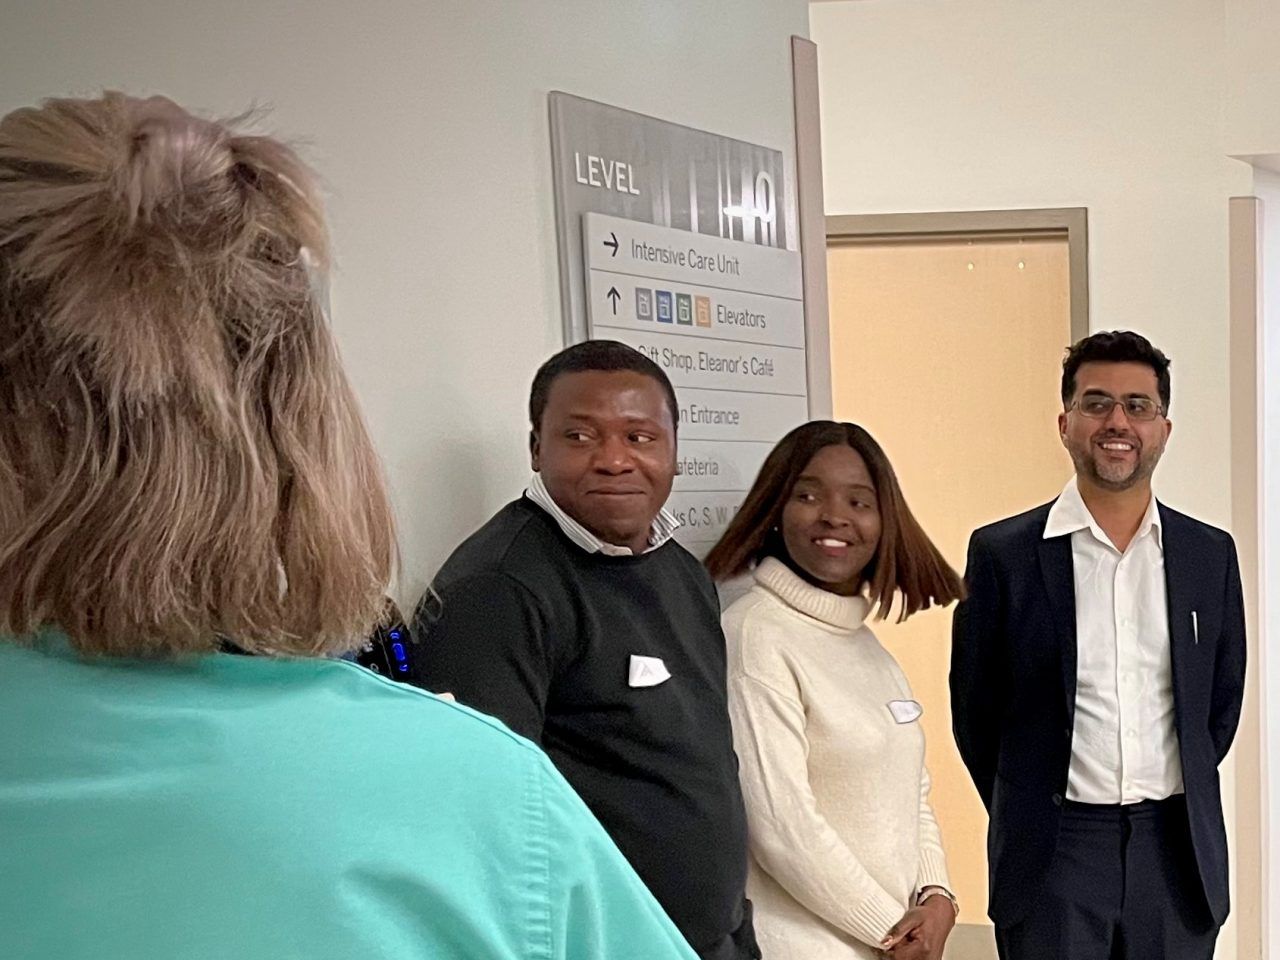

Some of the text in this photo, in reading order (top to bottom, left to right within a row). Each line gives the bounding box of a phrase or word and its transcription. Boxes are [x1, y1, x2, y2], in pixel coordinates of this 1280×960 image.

[575, 152, 640, 195] LEVEL
[631, 238, 740, 276] Intensive Care Unit
[716, 304, 767, 329] Elevators
[698, 351, 749, 375] Eleanor's
[690, 404, 739, 425] Entrance
[677, 456, 719, 476] afeteria
